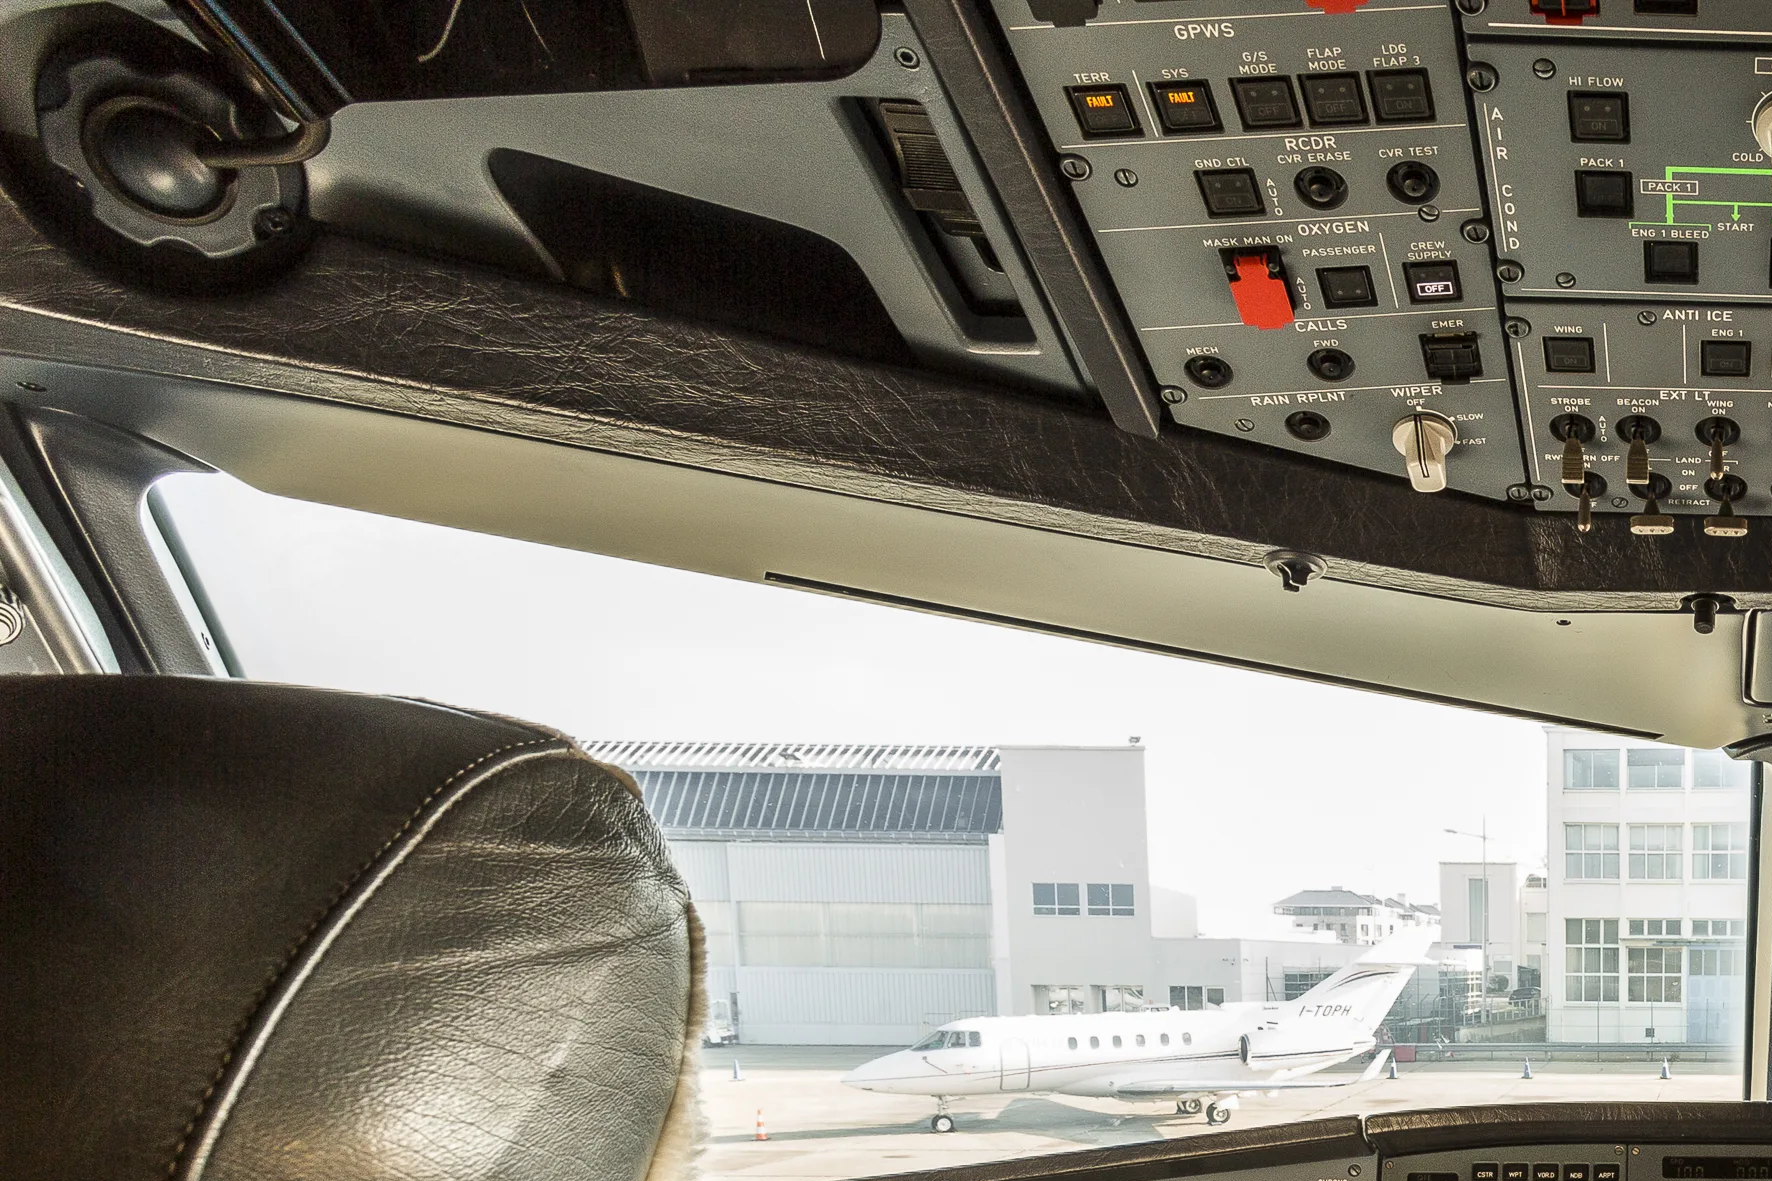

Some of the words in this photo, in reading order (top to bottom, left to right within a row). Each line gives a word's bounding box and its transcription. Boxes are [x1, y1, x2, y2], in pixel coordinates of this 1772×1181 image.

[1173, 23, 1235, 41] GPWS
[1307, 48, 1342, 59] FLAP
[1308, 60, 1346, 70] MODE
[1073, 73, 1110, 83] TERR
[1162, 68, 1189, 79] SYS
[1086, 95, 1113, 108] FAULT
[1168, 91, 1195, 104] FAULT
[1285, 136, 1337, 151] RCDR
[1277, 153, 1304, 163] CVR
[1311, 151, 1352, 161] ERASE
[1732, 152, 1763, 163] COLD
[1298, 221, 1369, 236] OXYGEN
[1717, 221, 1754, 232] START
[1632, 228, 1658, 238] ENG
[1671, 229, 1709, 239] BLEED
[1302, 245, 1376, 257] PASSENGER
[1411, 241, 1445, 251] CREW
[1408, 250, 1452, 261] SUPPLY
[1662, 310, 1698, 321] ANTI
[1707, 311, 1732, 322] ICE
[1295, 320, 1348, 333] CALLS
[1431, 319, 1464, 329] EMER
[1313, 339, 1338, 348] FWD
[1186, 346, 1219, 356] MECH
[1390, 386, 1443, 397] WIPER
[1659, 391, 1686, 400] EXT
[1696, 391, 1710, 400] LT
[1250, 395, 1291, 407] RAIN
[1296, 391, 1346, 404] RPLNT
[1407, 398, 1425, 407] OFF
[1551, 398, 1591, 406] STROBE
[1456, 412, 1484, 421] SLOW
[1299, 1005, 1352, 1018] I-TOPH
